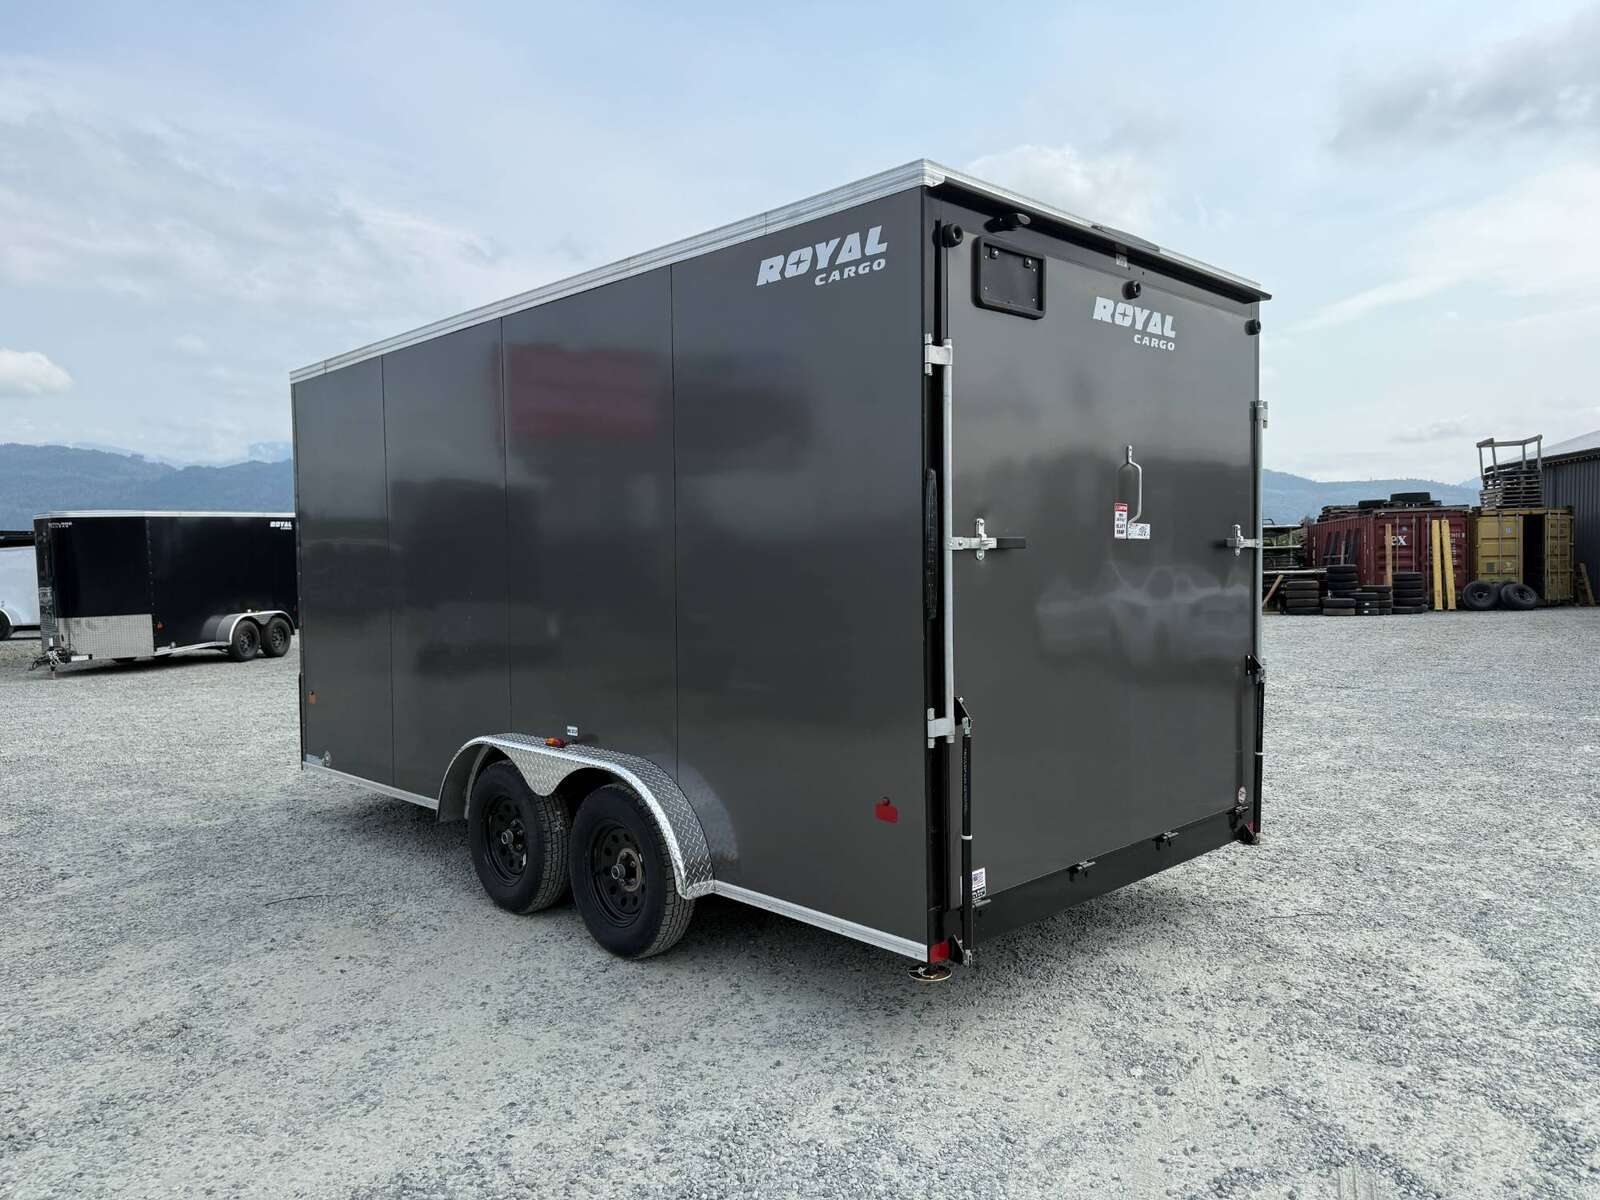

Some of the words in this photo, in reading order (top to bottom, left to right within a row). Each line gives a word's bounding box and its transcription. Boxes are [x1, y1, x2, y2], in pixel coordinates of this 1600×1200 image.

[756, 225, 888, 286] ROYAL
[814, 258, 886, 286] CARGO
[1093, 296, 1176, 338] ROYAL
[1134, 334, 1175, 351] CARGO
